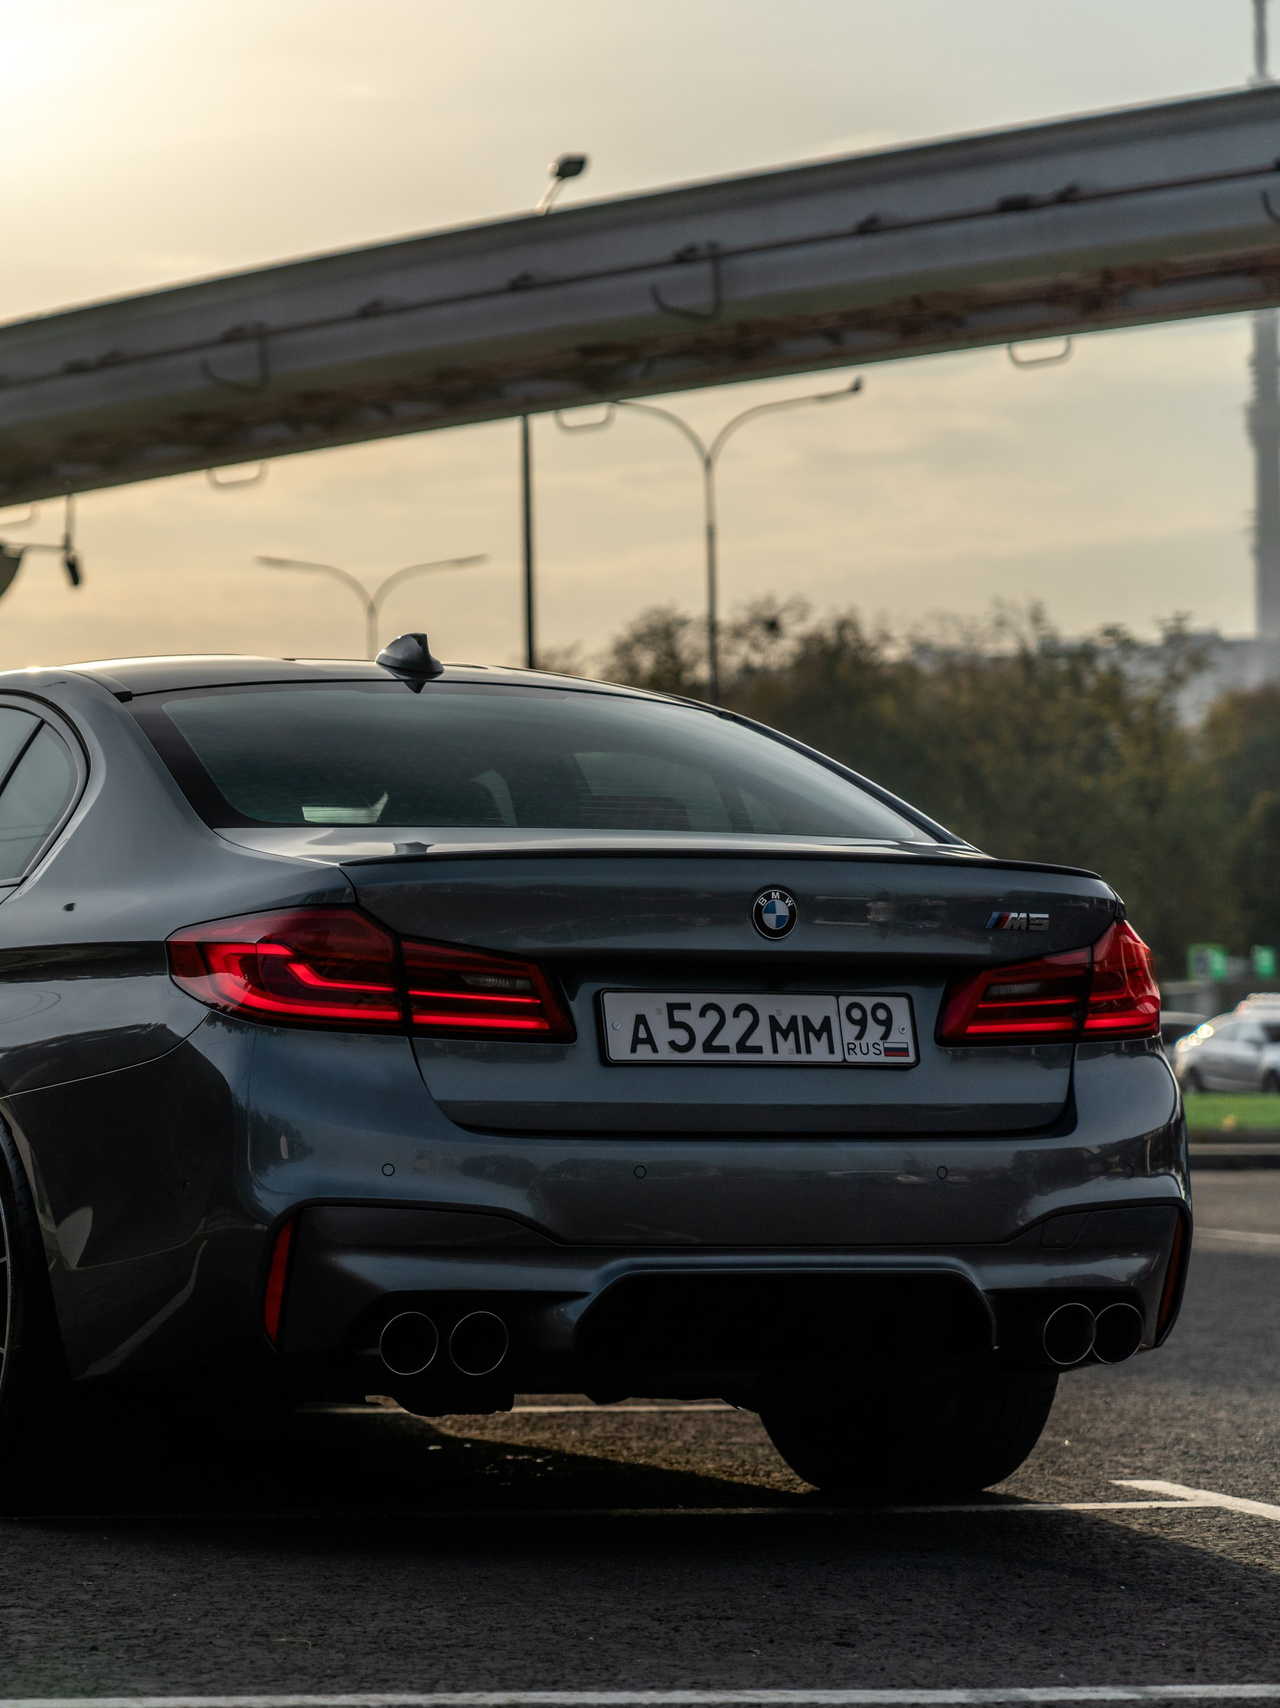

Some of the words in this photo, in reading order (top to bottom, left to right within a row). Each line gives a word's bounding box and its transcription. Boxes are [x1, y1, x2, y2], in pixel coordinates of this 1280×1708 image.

[758, 891, 794, 907] BMW
[1003, 911, 1049, 931] M5
[845, 1002, 893, 1041] 99
[846, 1042, 882, 1056] RUS
